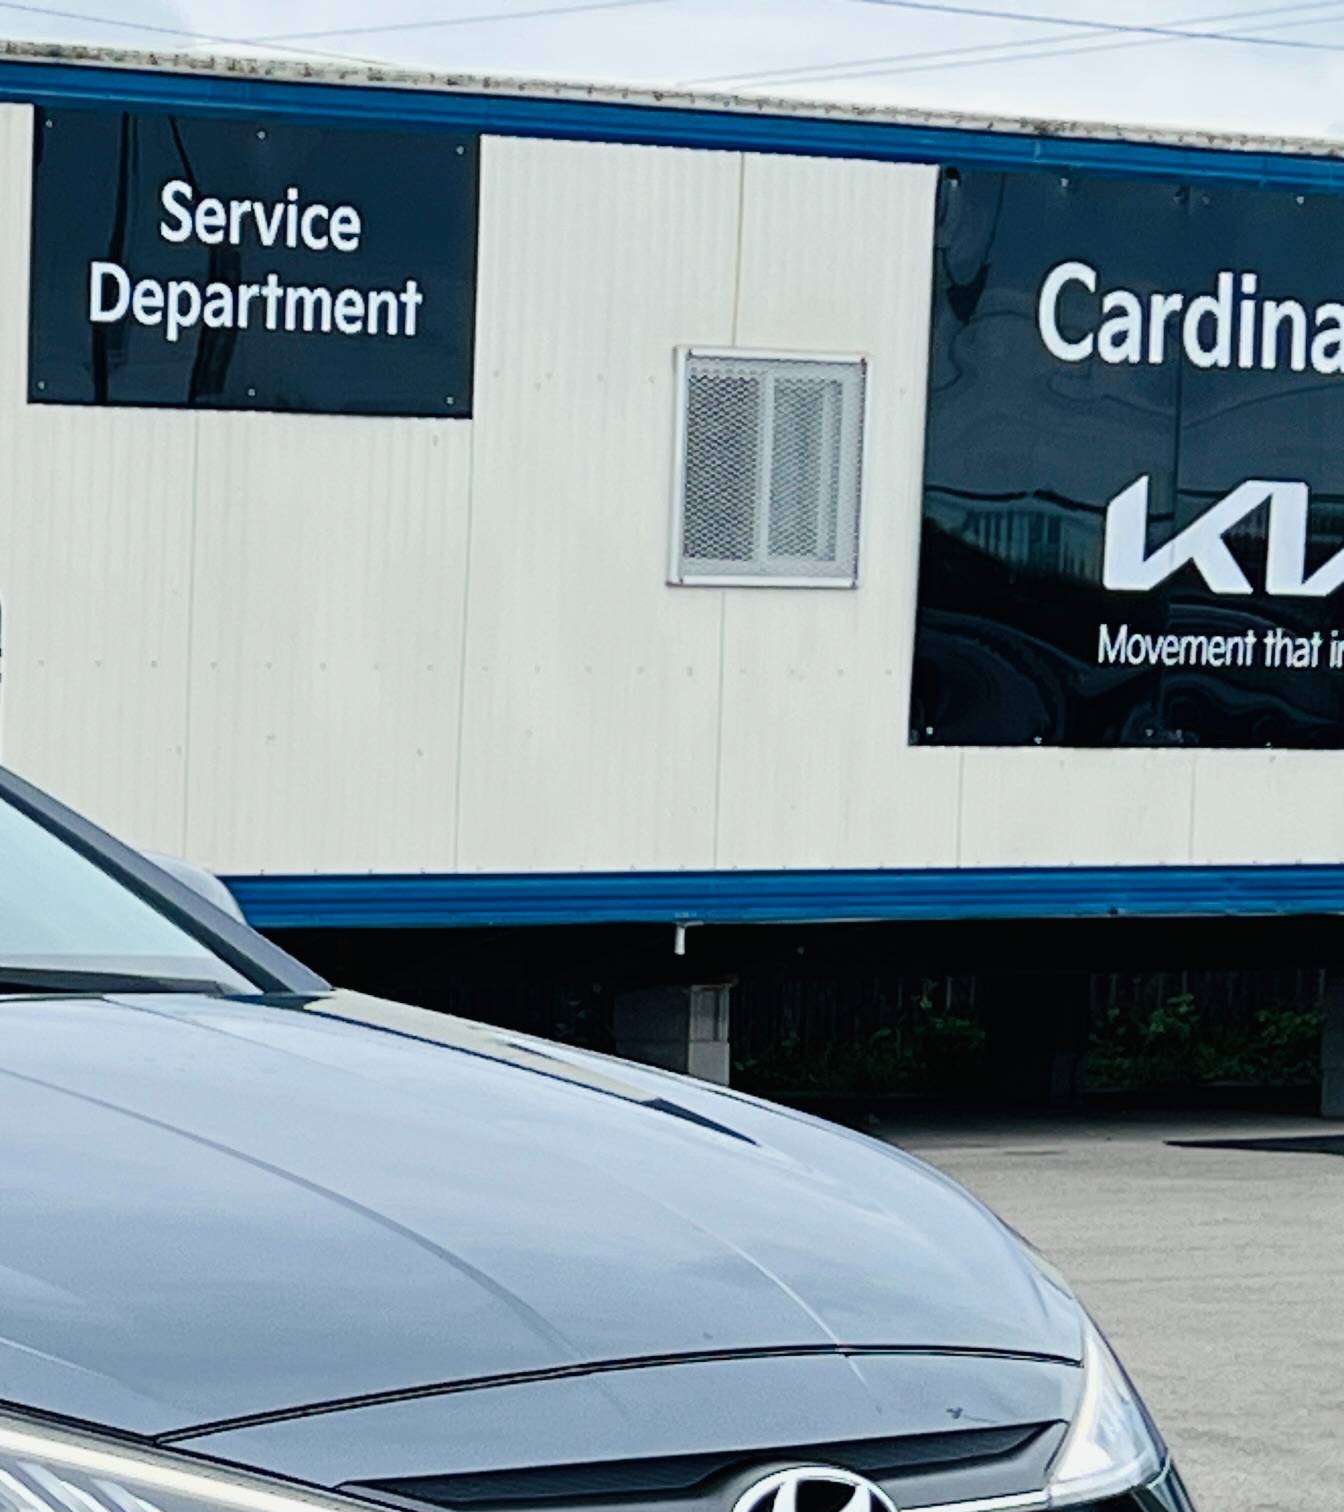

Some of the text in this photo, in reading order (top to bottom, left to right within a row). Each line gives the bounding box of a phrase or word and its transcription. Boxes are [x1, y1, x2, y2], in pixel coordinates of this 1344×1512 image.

[160, 179, 362, 252] Service
[89, 261, 423, 342] Department
[1037, 260, 1344, 374] Cardina
[1103, 475, 1344, 597] KI
[1098, 624, 1257, 667] Movement
[1264, 627, 1323, 669] that
